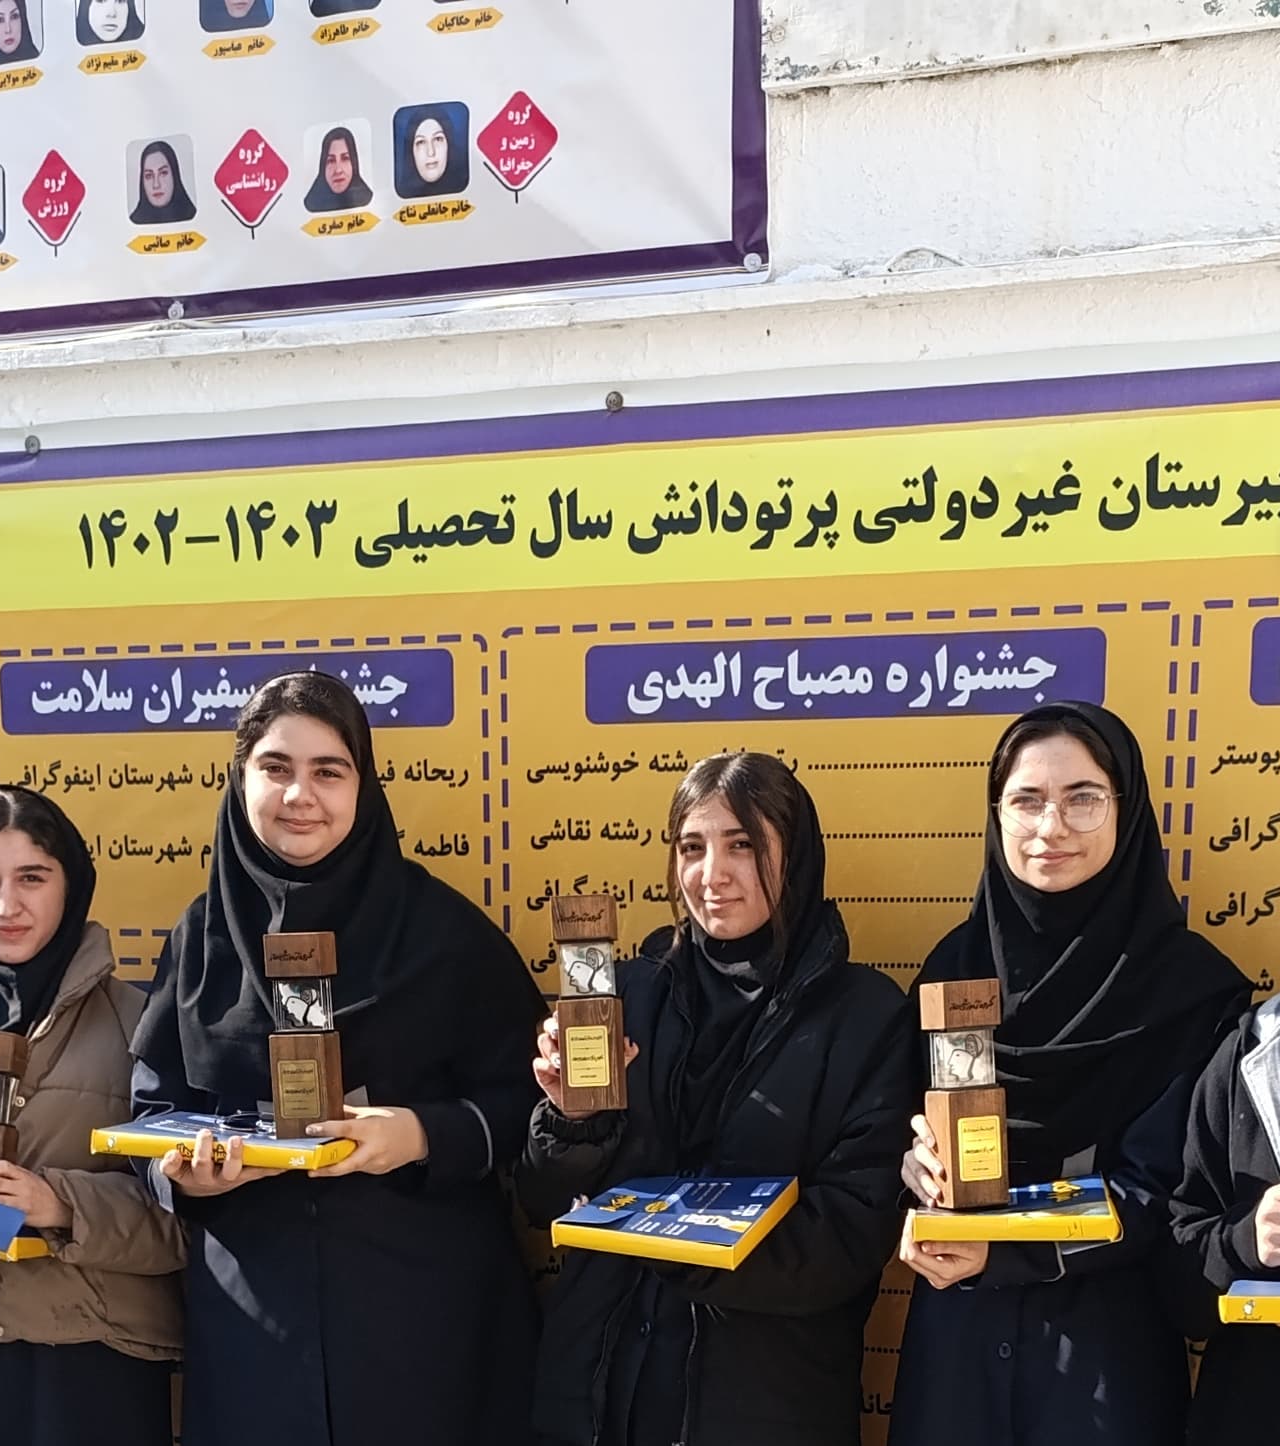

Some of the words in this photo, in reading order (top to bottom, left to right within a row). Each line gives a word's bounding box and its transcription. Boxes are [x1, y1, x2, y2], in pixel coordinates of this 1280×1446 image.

[353, 22, 370, 35] خانم
[475, 12, 493, 26] خانم
[247, 38, 266, 52] خانم
[86, 57, 101, 72] نژاد
[120, 53, 138, 67] خانم
[21, 70, 37, 83] خانم
[508, 105, 532, 126] گروه
[238, 141, 264, 164] گروه
[511, 134, 536, 151] زمین
[499, 156, 534, 177] جغرافیا
[44, 170, 67, 194] گروه
[225, 169, 277, 194] روانشناسی
[37, 198, 70, 219] ورزش
[418, 203, 449, 222] جانعلی
[449, 199, 472, 217] خانم
[345, 214, 366, 230] خانم
[176, 233, 195, 249] خانم
[853, 460, 1083, 545] غیردولتی
[354, 492, 517, 570] تحصیلی
[529, 488, 613, 560] سال
[626, 650, 742, 717] الهدی
[752, 648, 874, 712] مصباح
[884, 642, 1058, 708] جشنواره
[31, 667, 134, 714] سلامت
[142, 667, 255, 726] سفیران
[108, 763, 194, 793] شهرستان
[404, 757, 470, 794] ریحانه
[525, 747, 640, 785] خوشنویسی
[529, 819, 591, 851] نقاشی
[600, 818, 652, 847] رشته
[108, 834, 193, 865] شهرستان
[413, 834, 470, 858] فاطمه
